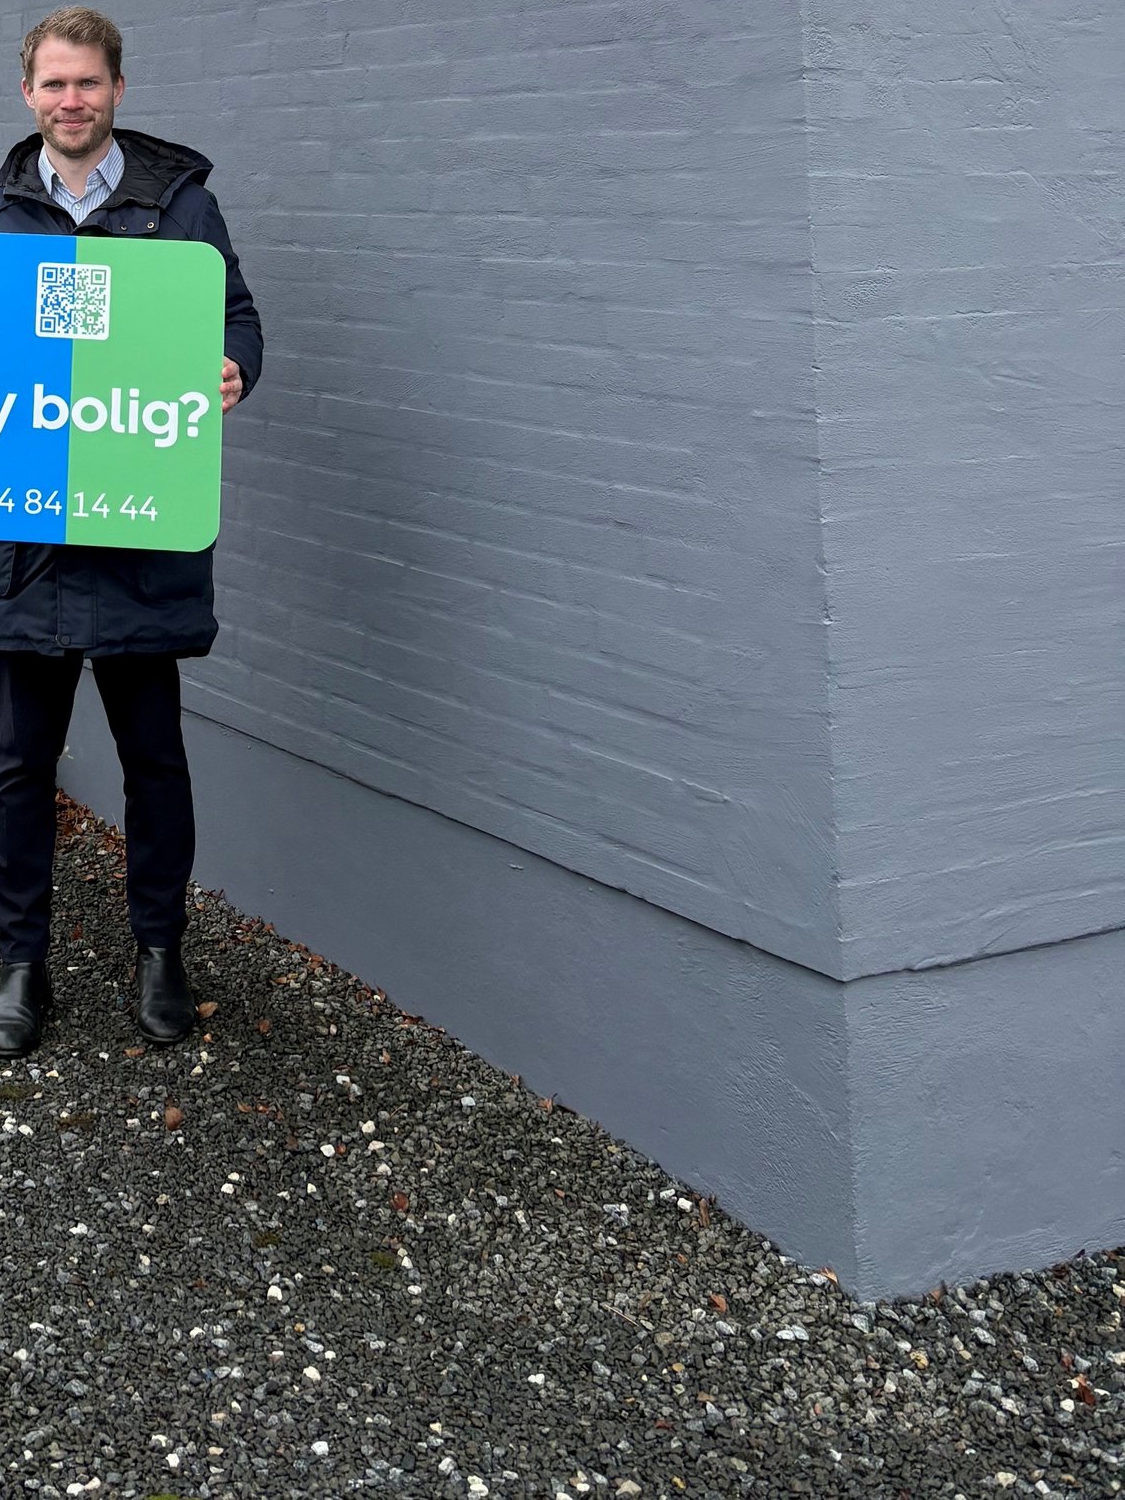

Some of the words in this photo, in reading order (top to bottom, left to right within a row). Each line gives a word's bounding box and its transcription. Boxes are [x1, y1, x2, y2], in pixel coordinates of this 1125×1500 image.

[32, 383, 210, 448] bolig?
[23, 487, 63, 516] 84
[71, 490, 111, 519] 14
[118, 493, 159, 522] 44
